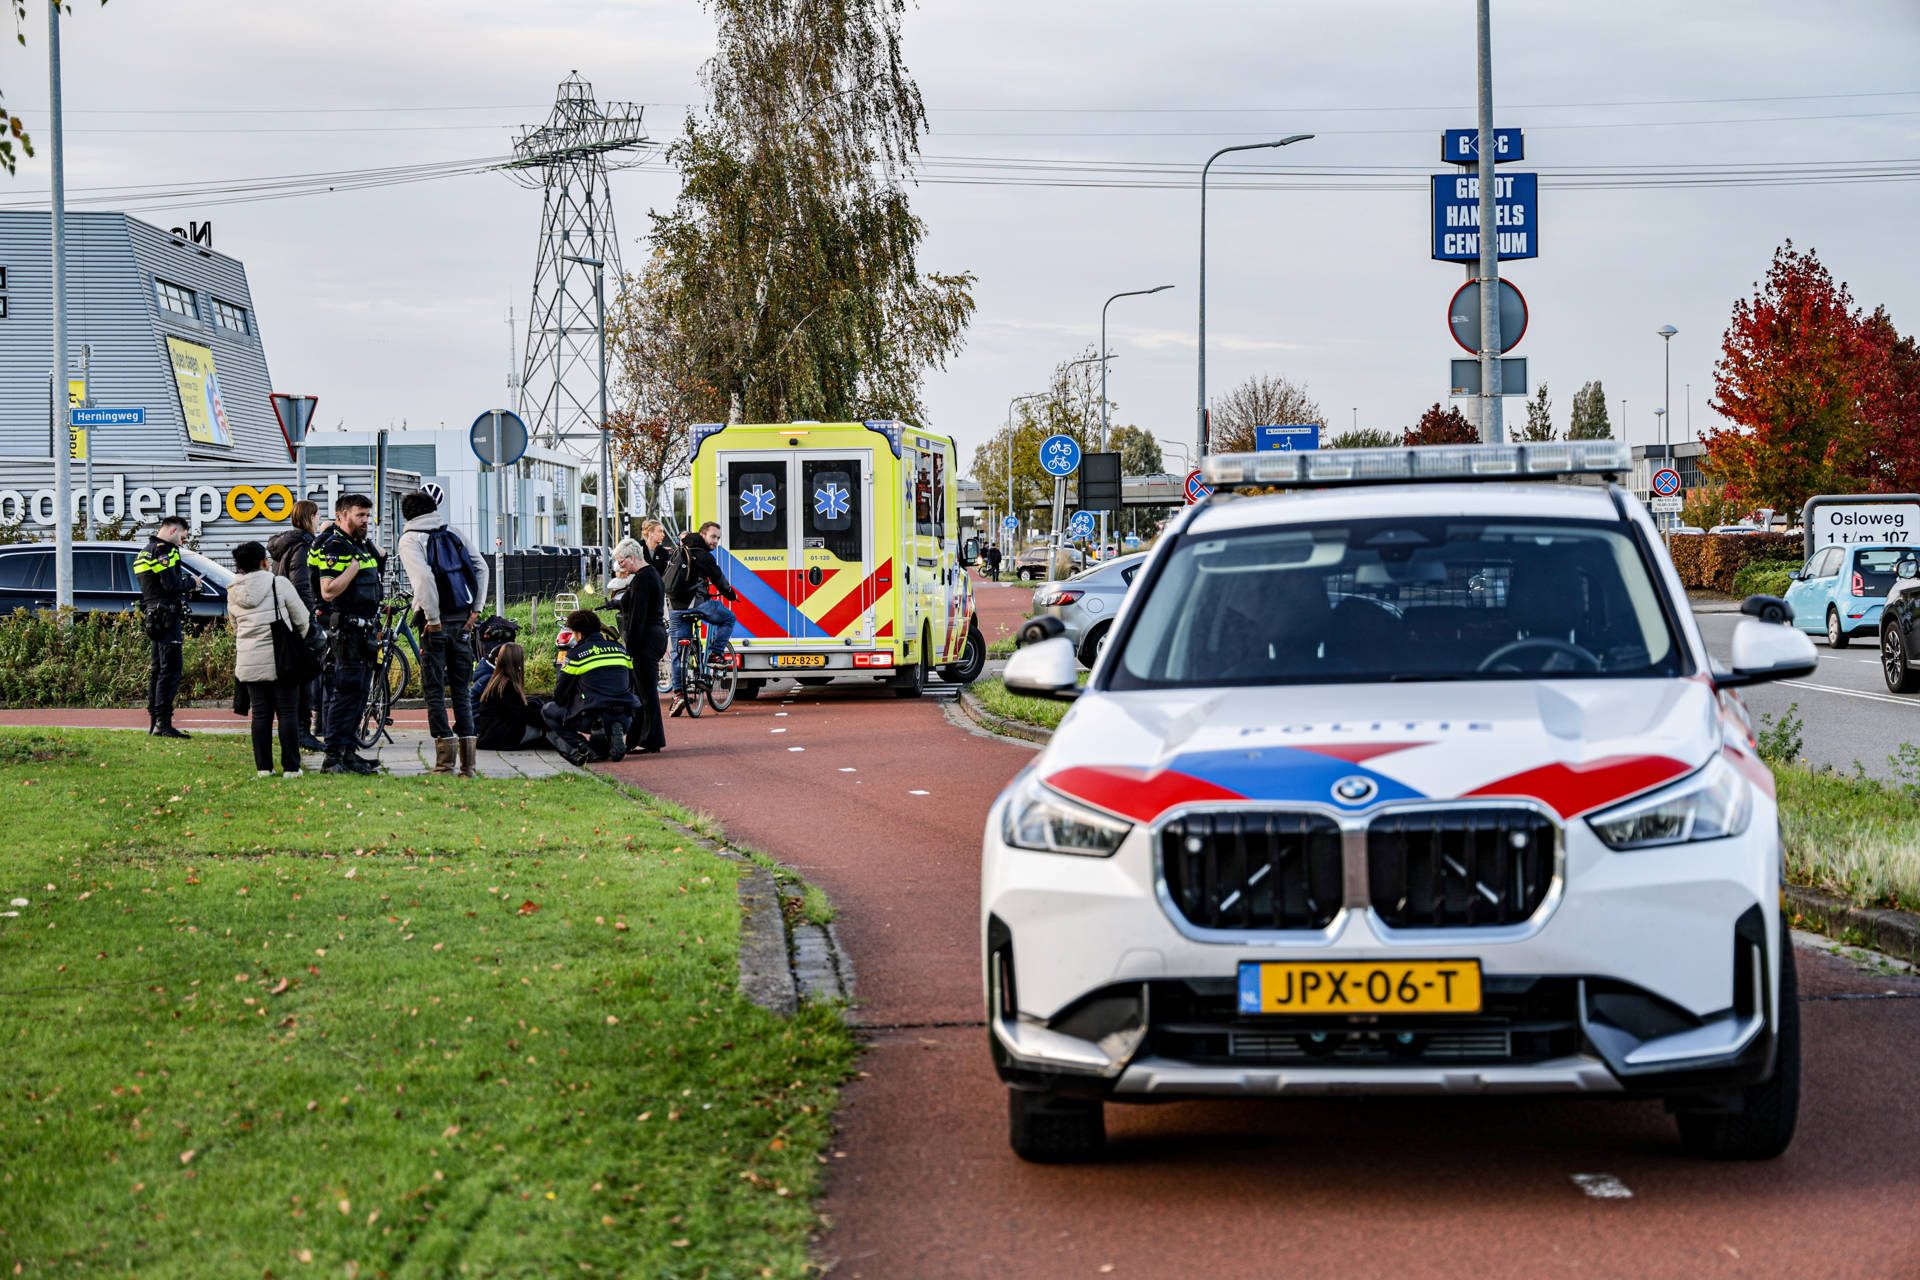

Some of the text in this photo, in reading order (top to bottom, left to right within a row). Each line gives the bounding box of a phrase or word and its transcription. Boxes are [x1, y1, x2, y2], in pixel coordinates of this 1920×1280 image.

[1456, 177, 1514, 199] GROT
[1446, 205, 1524, 227] HANELS
[1444, 232, 1527, 255] CENUM
[77, 411, 139, 423] Herningweg
[1830, 512, 1904, 528] Osloweg
[1827, 532, 1835, 543] 1
[1882, 531, 1909, 543] 107
[781, 656, 820, 665] JLZ-82-S
[1240, 722, 1493, 736] POLITIE
[1276, 969, 1459, 1005] JPX-06-T
